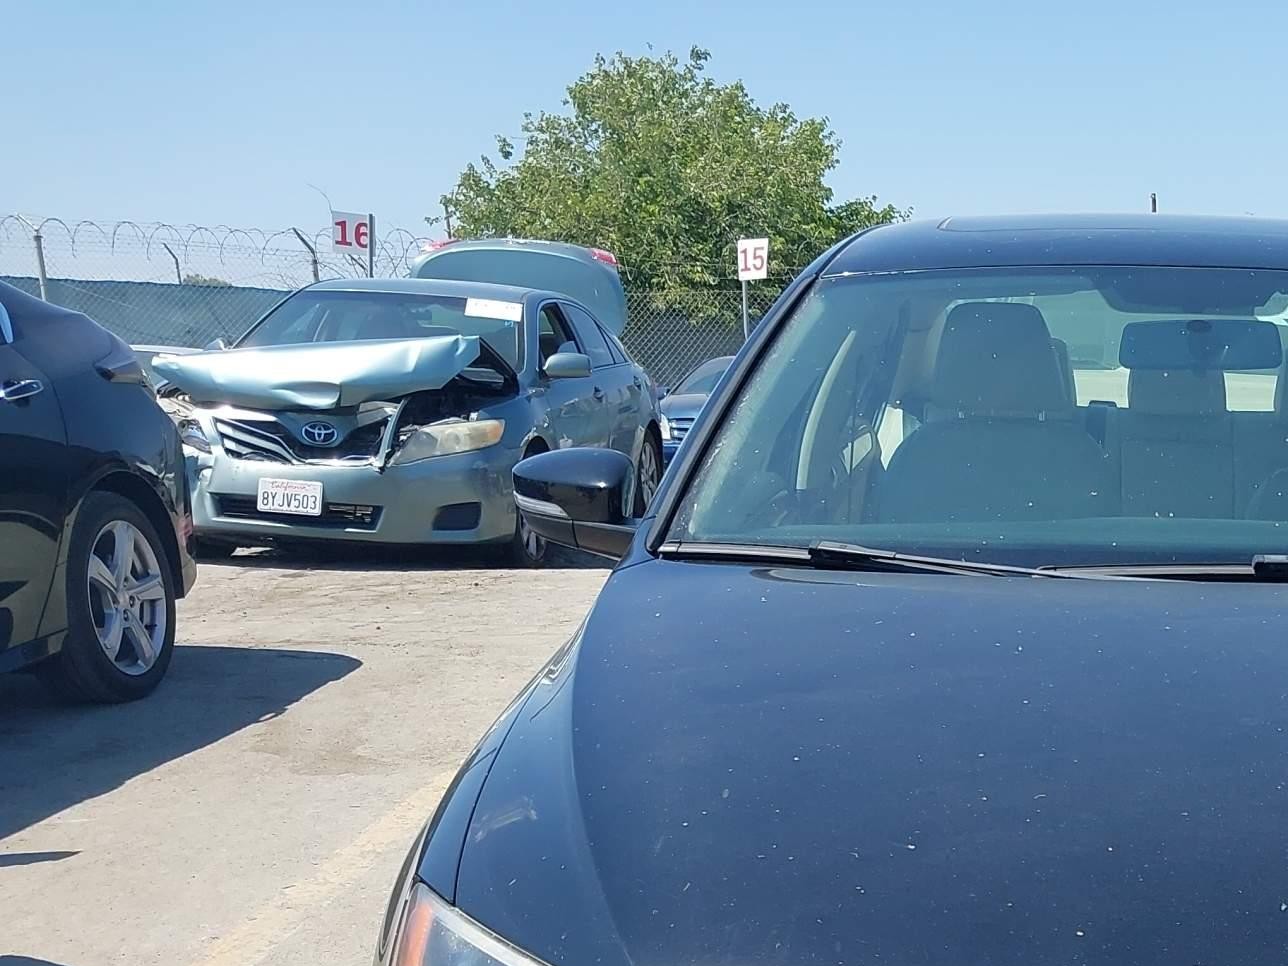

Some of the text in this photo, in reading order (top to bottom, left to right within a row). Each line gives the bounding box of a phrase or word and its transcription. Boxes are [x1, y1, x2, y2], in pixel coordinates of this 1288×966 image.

[335, 220, 368, 249] 16
[740, 246, 764, 272] 15
[261, 490, 318, 510] 8YJV503
